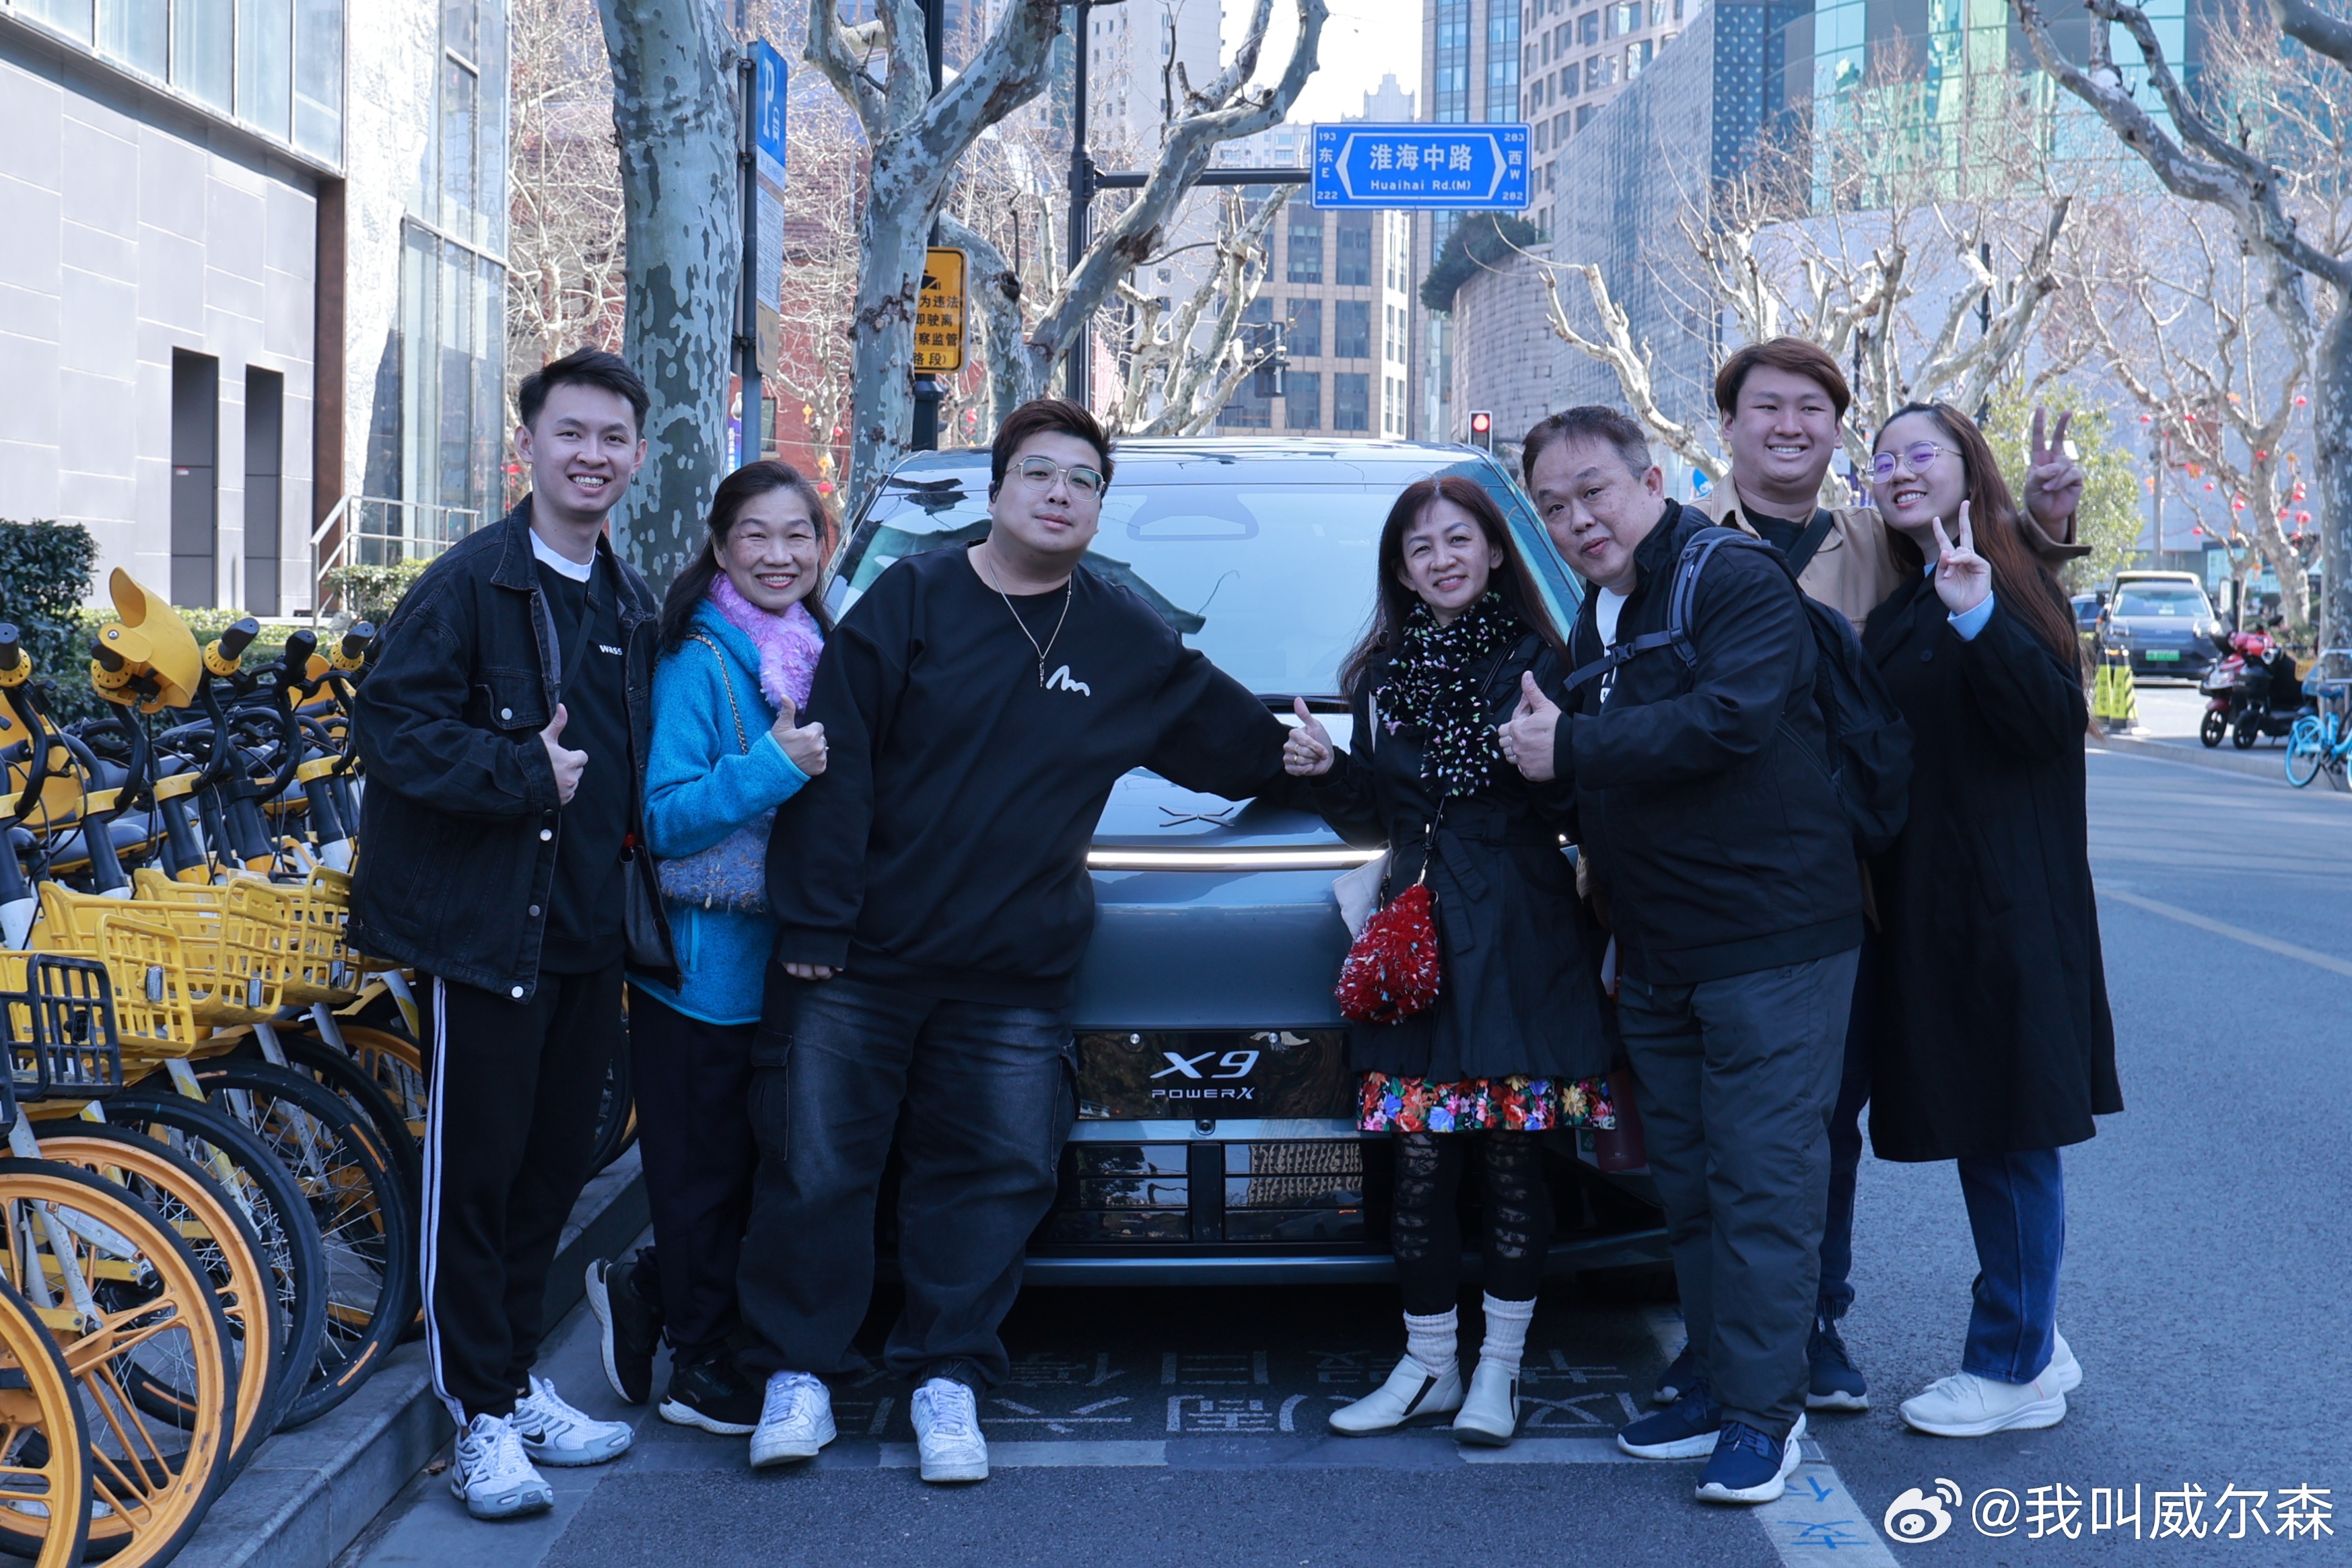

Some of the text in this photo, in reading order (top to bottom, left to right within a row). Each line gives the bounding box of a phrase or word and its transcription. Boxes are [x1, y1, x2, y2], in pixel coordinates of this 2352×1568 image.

[1319, 132, 1337, 141] 193
[1504, 133, 1525, 142] 283
[1319, 147, 1334, 164] 东
[1370, 143, 1473, 172] 淮海中路
[1508, 150, 1523, 166] 西
[1321, 168, 1329, 179] E
[1510, 170, 1520, 180] W
[1371, 180, 1472, 192] Huaihai Rd.(M)
[1317, 190, 1338, 200] 222
[1502, 191, 1523, 201] 282
[913, 332, 958, 347] 察监管
[1150, 1050, 1259, 1079] X9
[1152, 1087, 1255, 1100] POWERX
